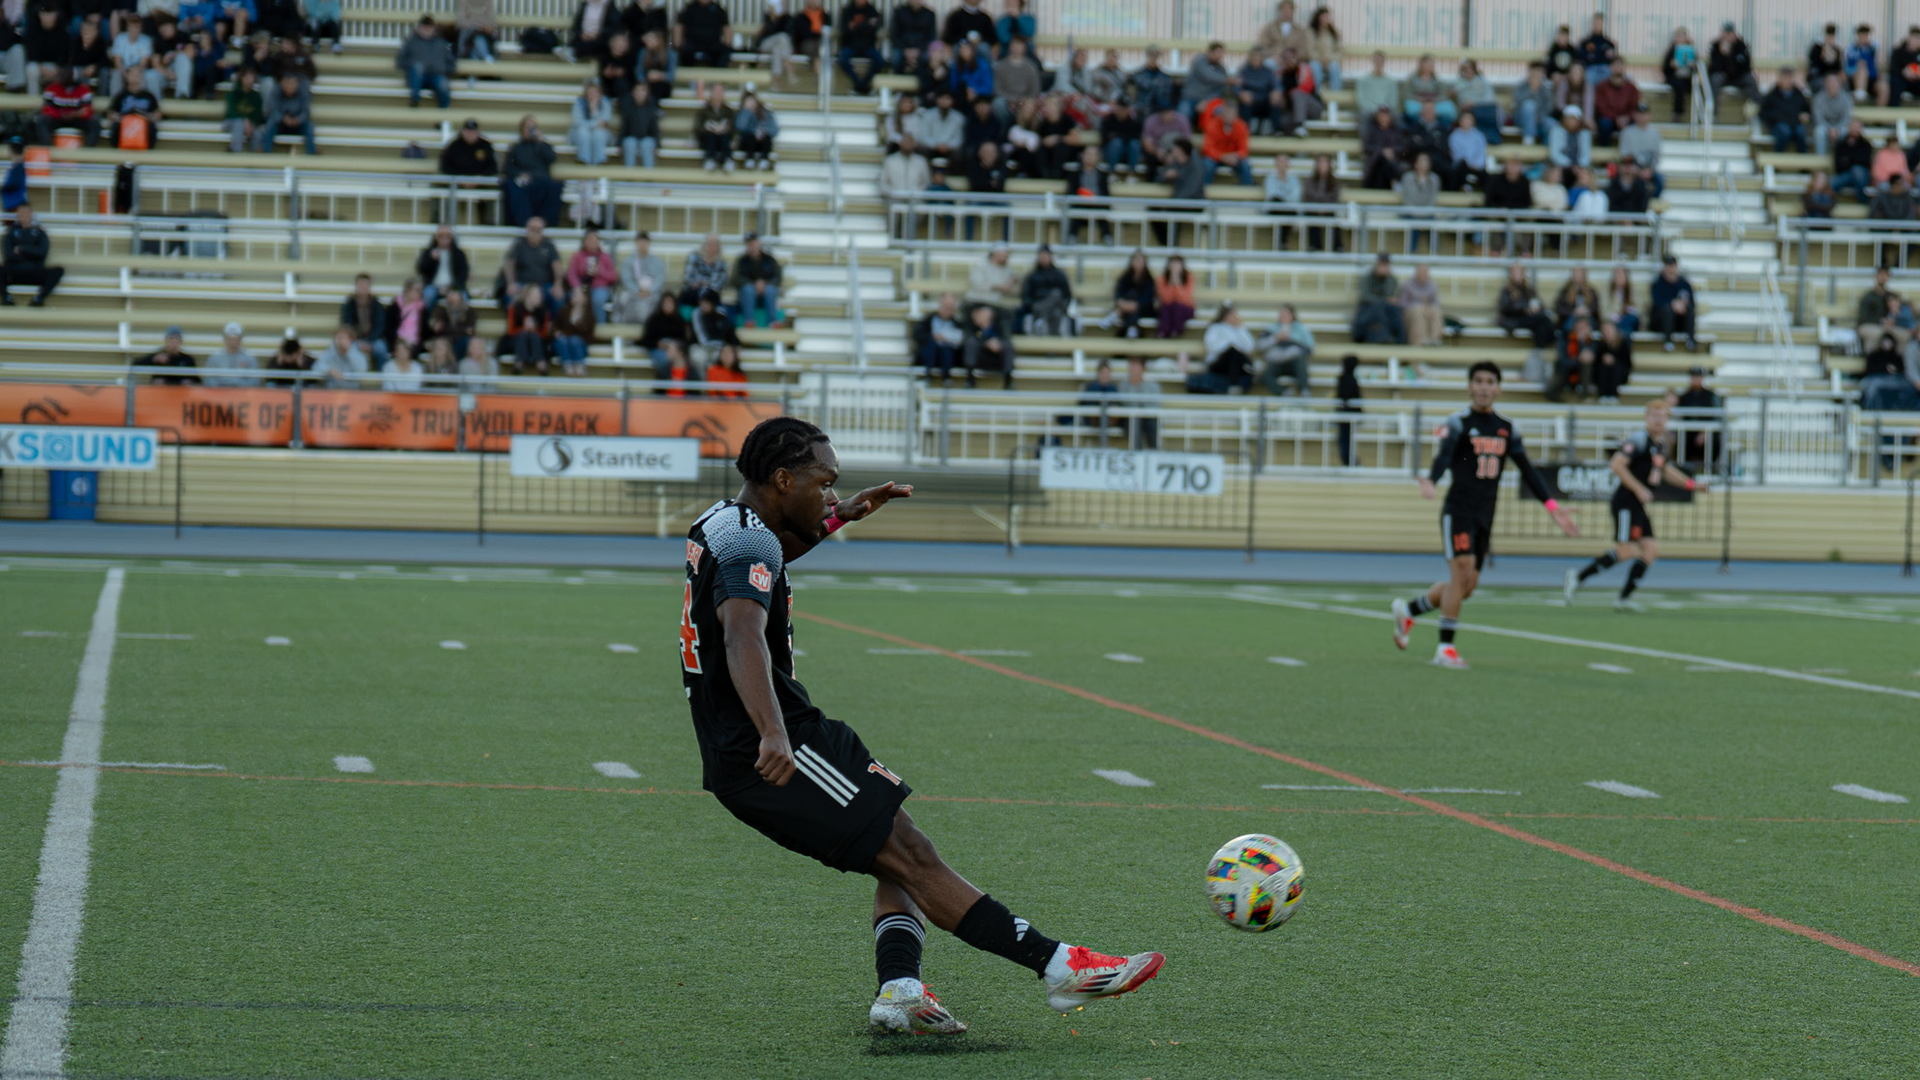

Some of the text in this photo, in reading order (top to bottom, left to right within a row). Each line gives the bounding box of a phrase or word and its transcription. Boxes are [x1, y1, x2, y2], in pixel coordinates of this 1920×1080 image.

[182, 402, 250, 428] HOME
[258, 403, 288, 429] OF
[305, 404, 350, 432] THE
[410, 407, 453, 435] TRU
[1470, 436, 1506, 455] TRU
[581, 447, 673, 471] Stantec
[1052, 451, 1136, 474] STITES
[1157, 463, 1211, 491] 710
[752, 572, 768, 588] CW
[868, 759, 902, 786] 1
